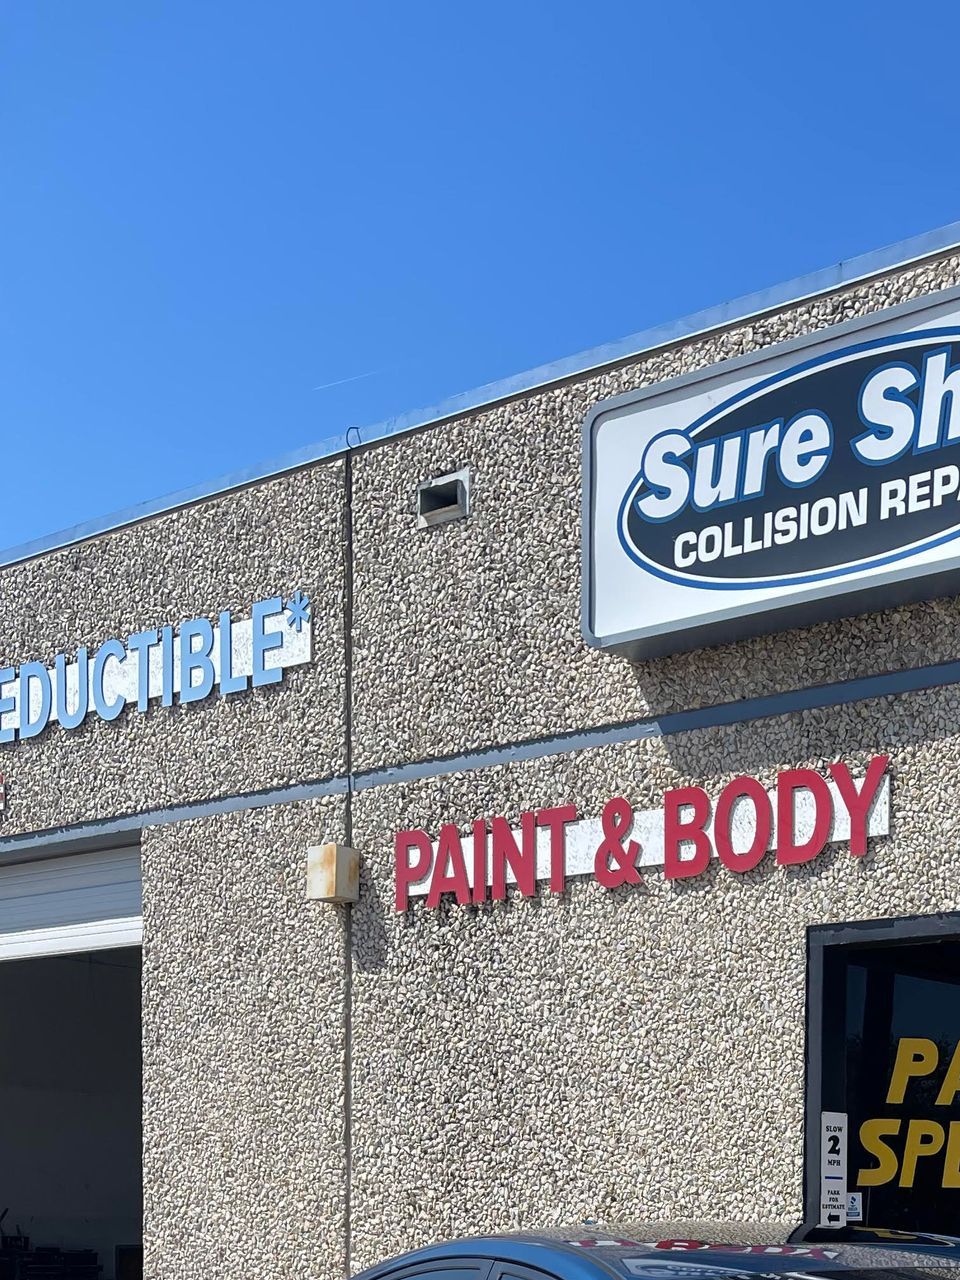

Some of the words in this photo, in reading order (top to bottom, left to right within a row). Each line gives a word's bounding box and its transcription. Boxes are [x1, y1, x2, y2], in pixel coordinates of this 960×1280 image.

[634, 409, 832, 521] Sure
[673, 487, 869, 569] COLLISION
[395, 804, 577, 912] PAINT
[594, 797, 643, 889] &
[664, 755, 890, 881] BODY
[825, 1125, 843, 1133] SLOW
[827, 1134, 841, 1156] 2
[827, 1159, 841, 1167] MPH
